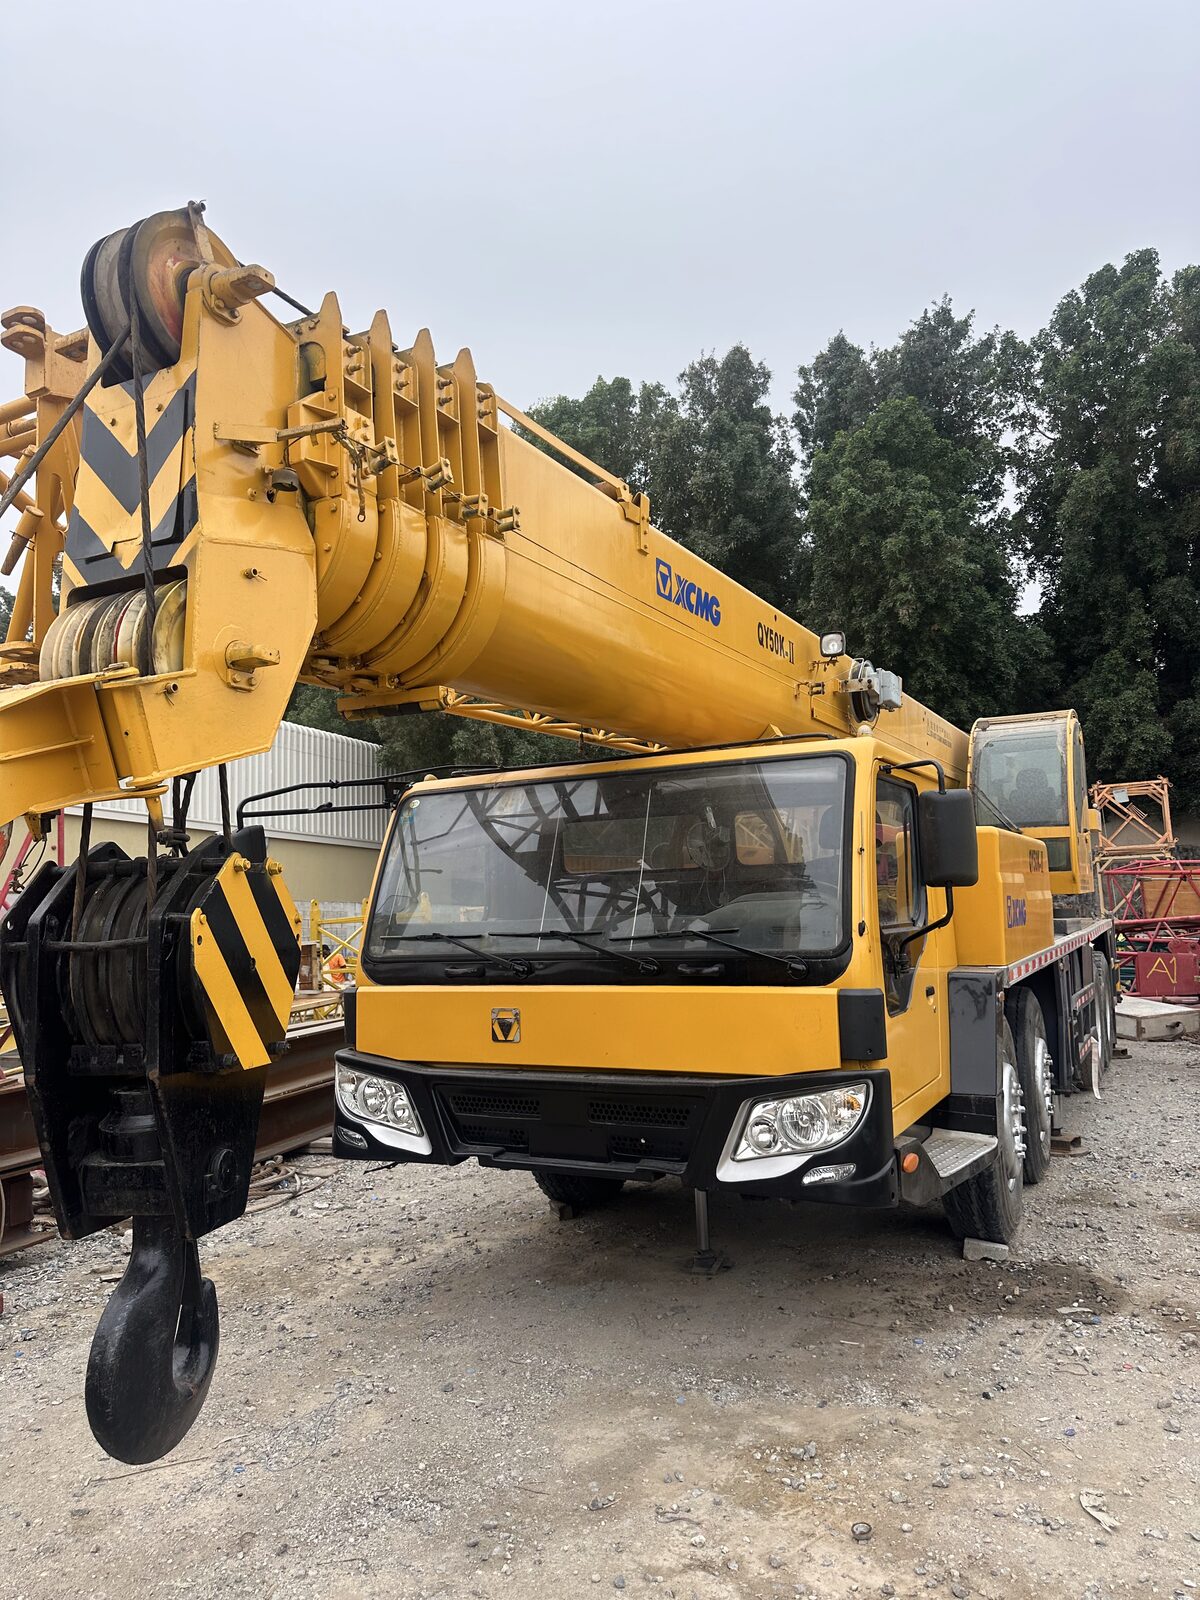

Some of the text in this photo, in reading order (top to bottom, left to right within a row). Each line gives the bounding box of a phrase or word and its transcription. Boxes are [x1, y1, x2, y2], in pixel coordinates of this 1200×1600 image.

[673, 573, 721, 627] XCMG
[757, 622, 795, 665] QY50K-II
[1146, 956, 1178, 984] A1
